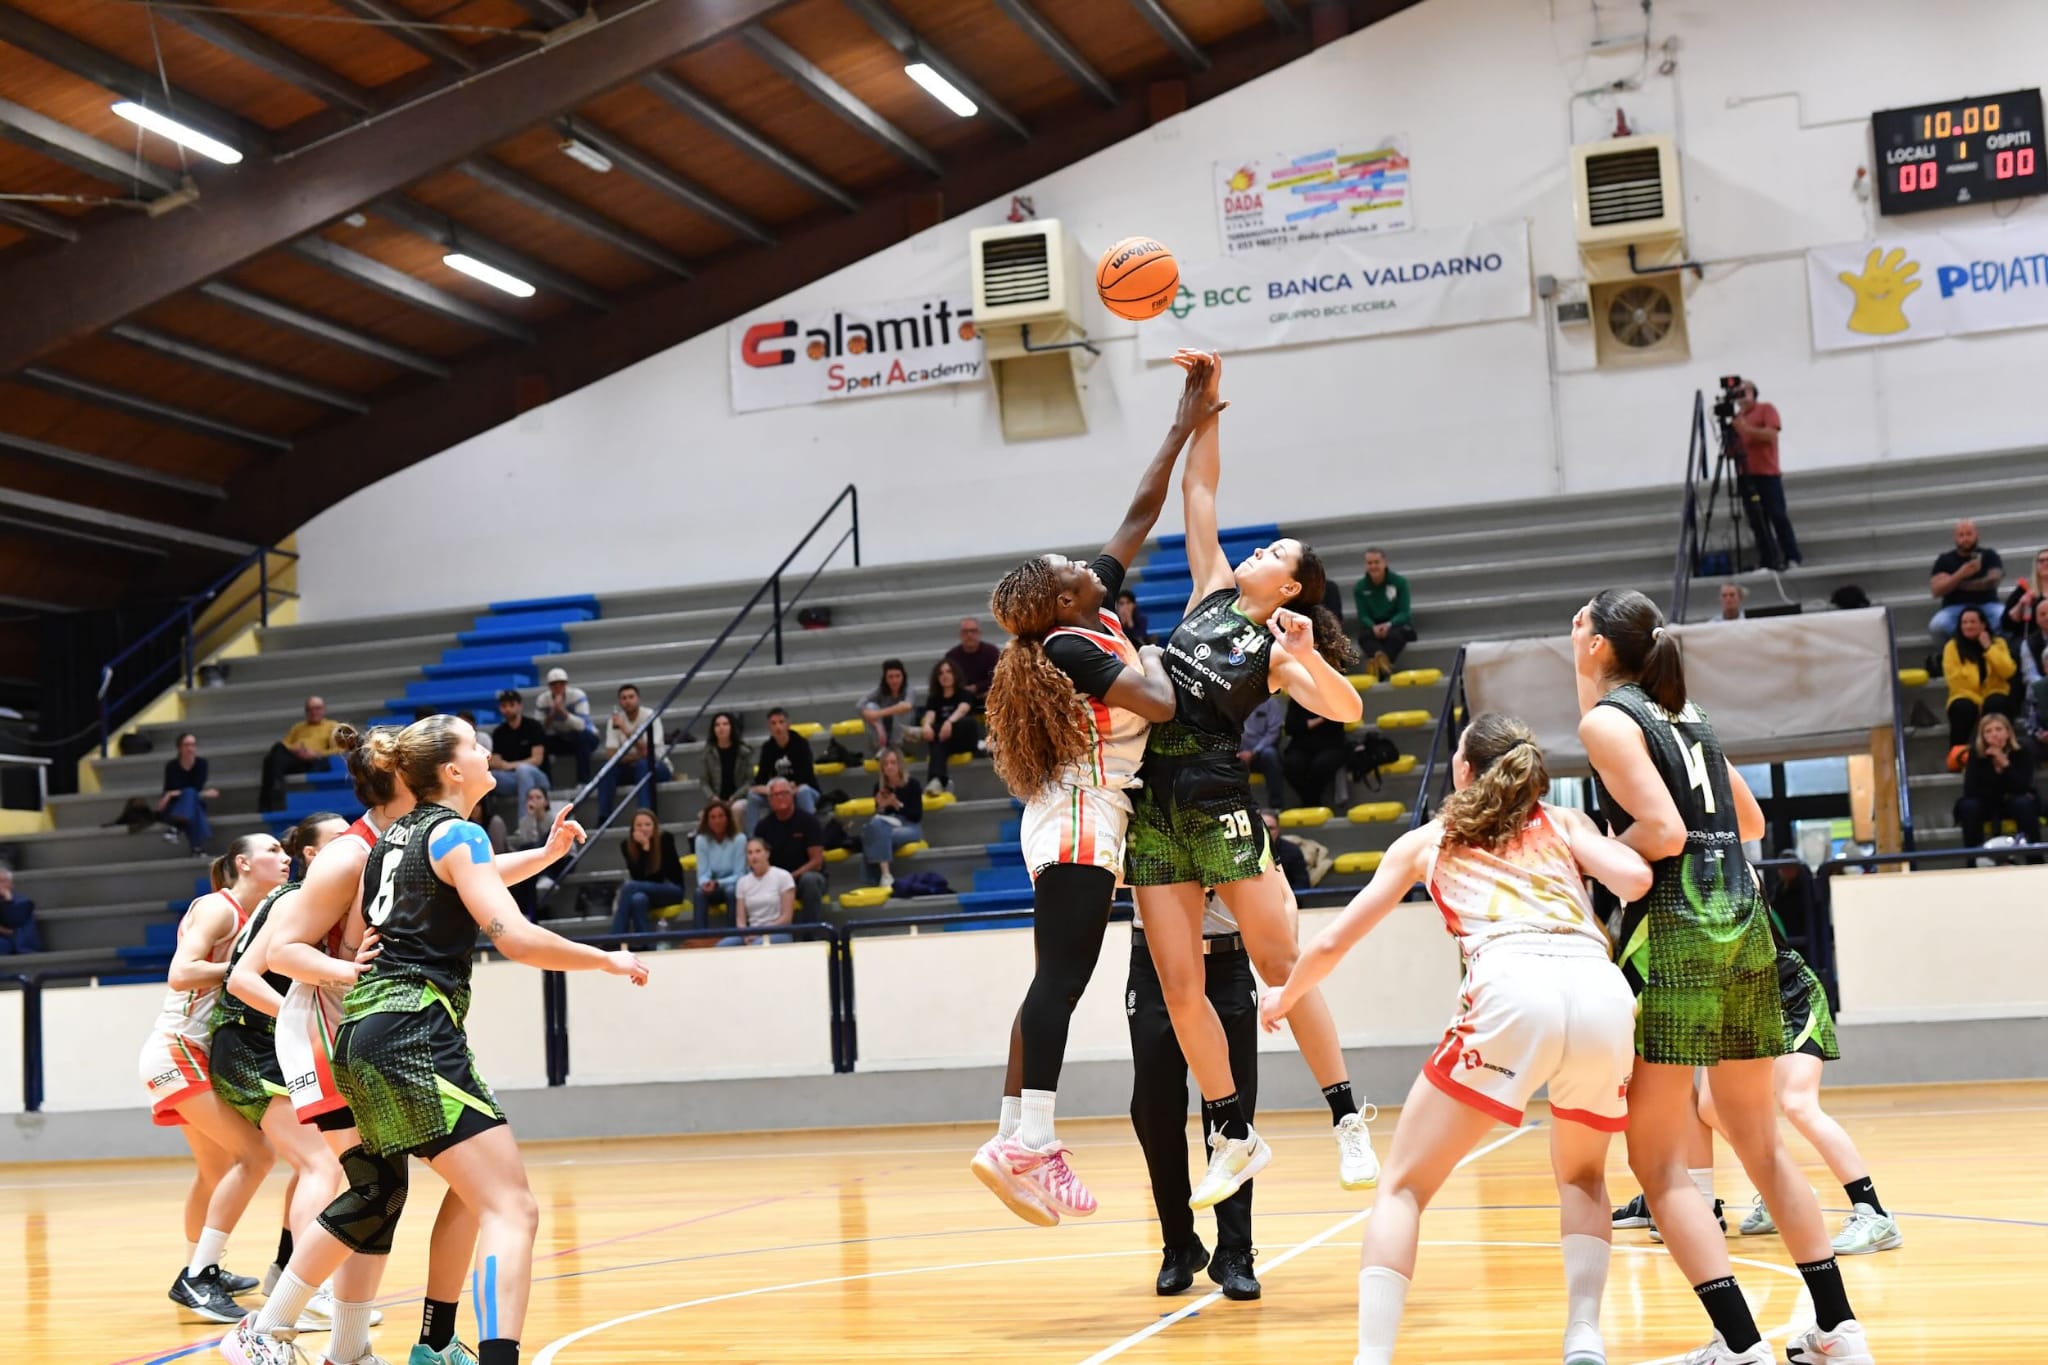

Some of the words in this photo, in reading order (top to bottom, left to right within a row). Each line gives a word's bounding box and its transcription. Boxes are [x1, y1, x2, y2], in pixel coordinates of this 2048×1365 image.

[1923, 104, 2000, 139] 10.00
[1886, 145, 1937, 164] LOCALI
[1959, 141, 1967, 159] 1
[1986, 130, 2032, 150] OSPITI
[1899, 162, 1937, 192] 00
[1996, 148, 2034, 179] 00
[1225, 193, 1263, 214] DADA
[1111, 242, 1164, 269] Wilson
[1204, 286, 1251, 307] BCC
[1267, 273, 1352, 299] BANCA
[1363, 252, 1503, 287] VALDARNO
[1269, 307, 1320, 324] GRUPPO
[1324, 304, 1349, 317] BCC
[1351, 298, 1397, 313] ICCREA
[828, 364, 882, 392] Sport
[886, 359, 982, 386] Academy
[1218, 809, 1252, 839] 38
[368, 848, 404, 927] 6
